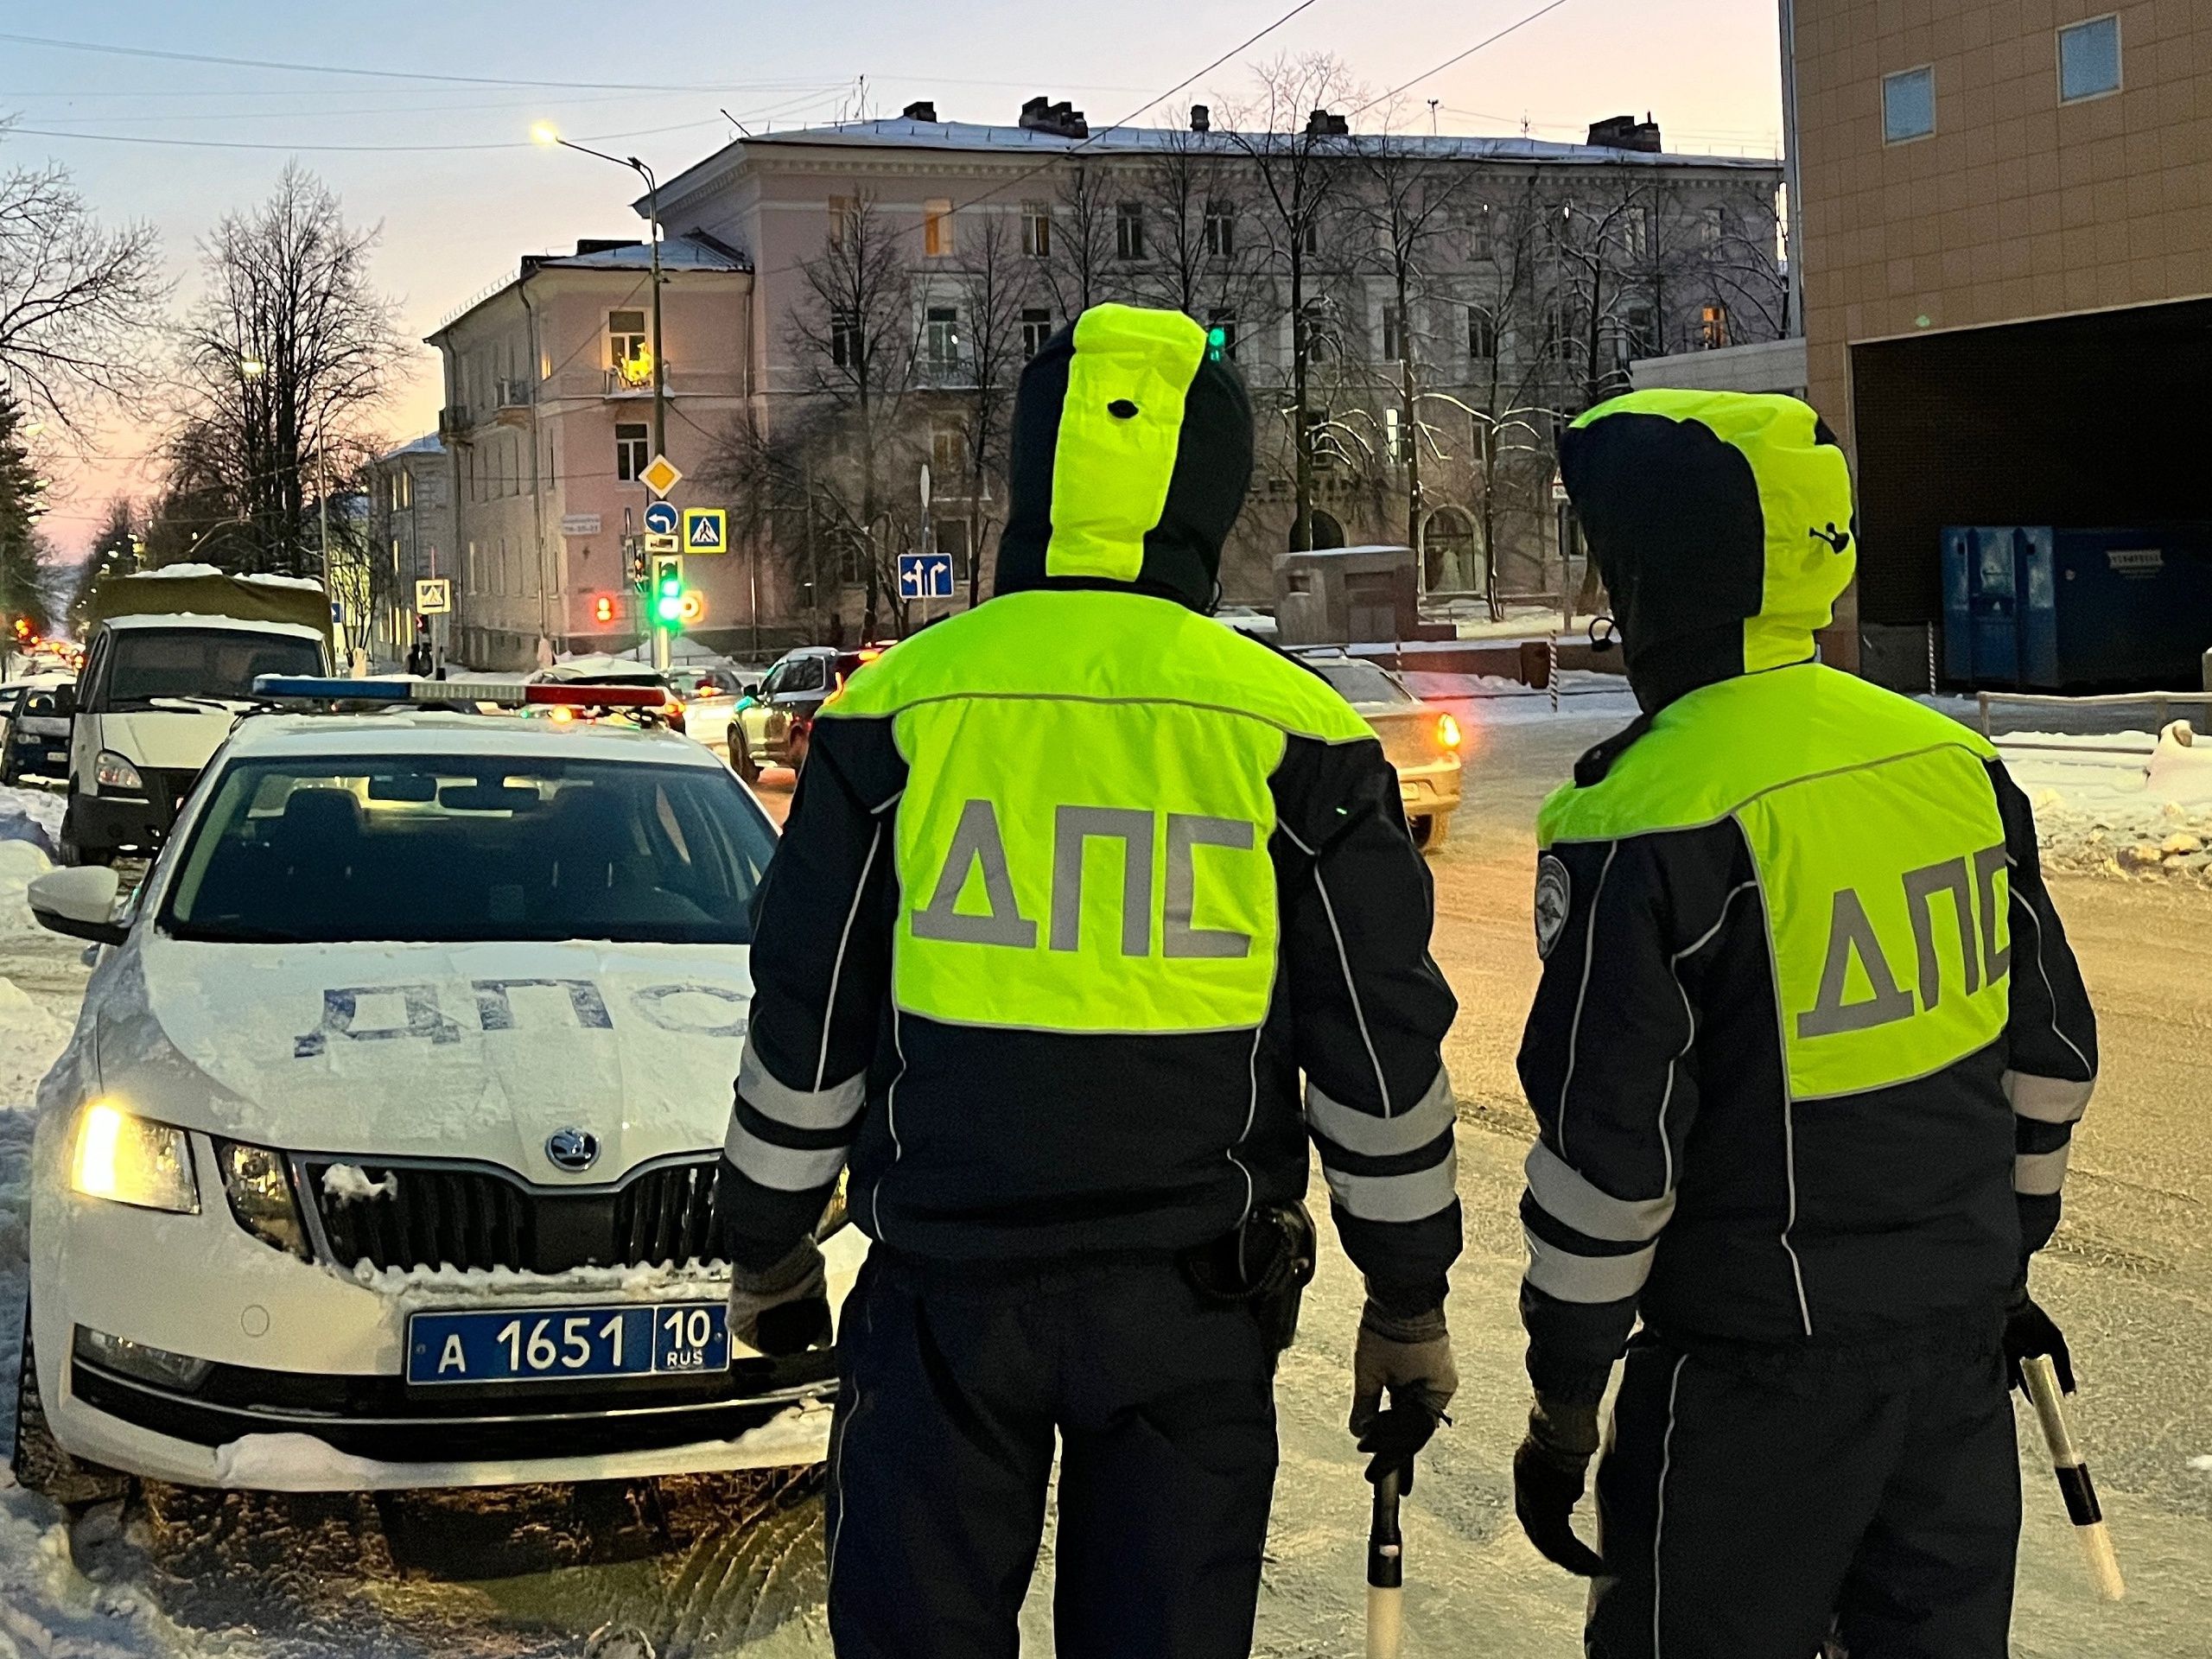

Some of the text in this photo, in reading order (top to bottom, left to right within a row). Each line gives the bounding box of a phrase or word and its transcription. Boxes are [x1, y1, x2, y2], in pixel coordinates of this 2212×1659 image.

[912, 798, 1254, 958] ДПС
[1797, 842, 2011, 1039] ДПС
[295, 978, 750, 1058] ДПС
[438, 1310, 710, 1373] А 1651 10
[666, 1351, 703, 1366] RUS
